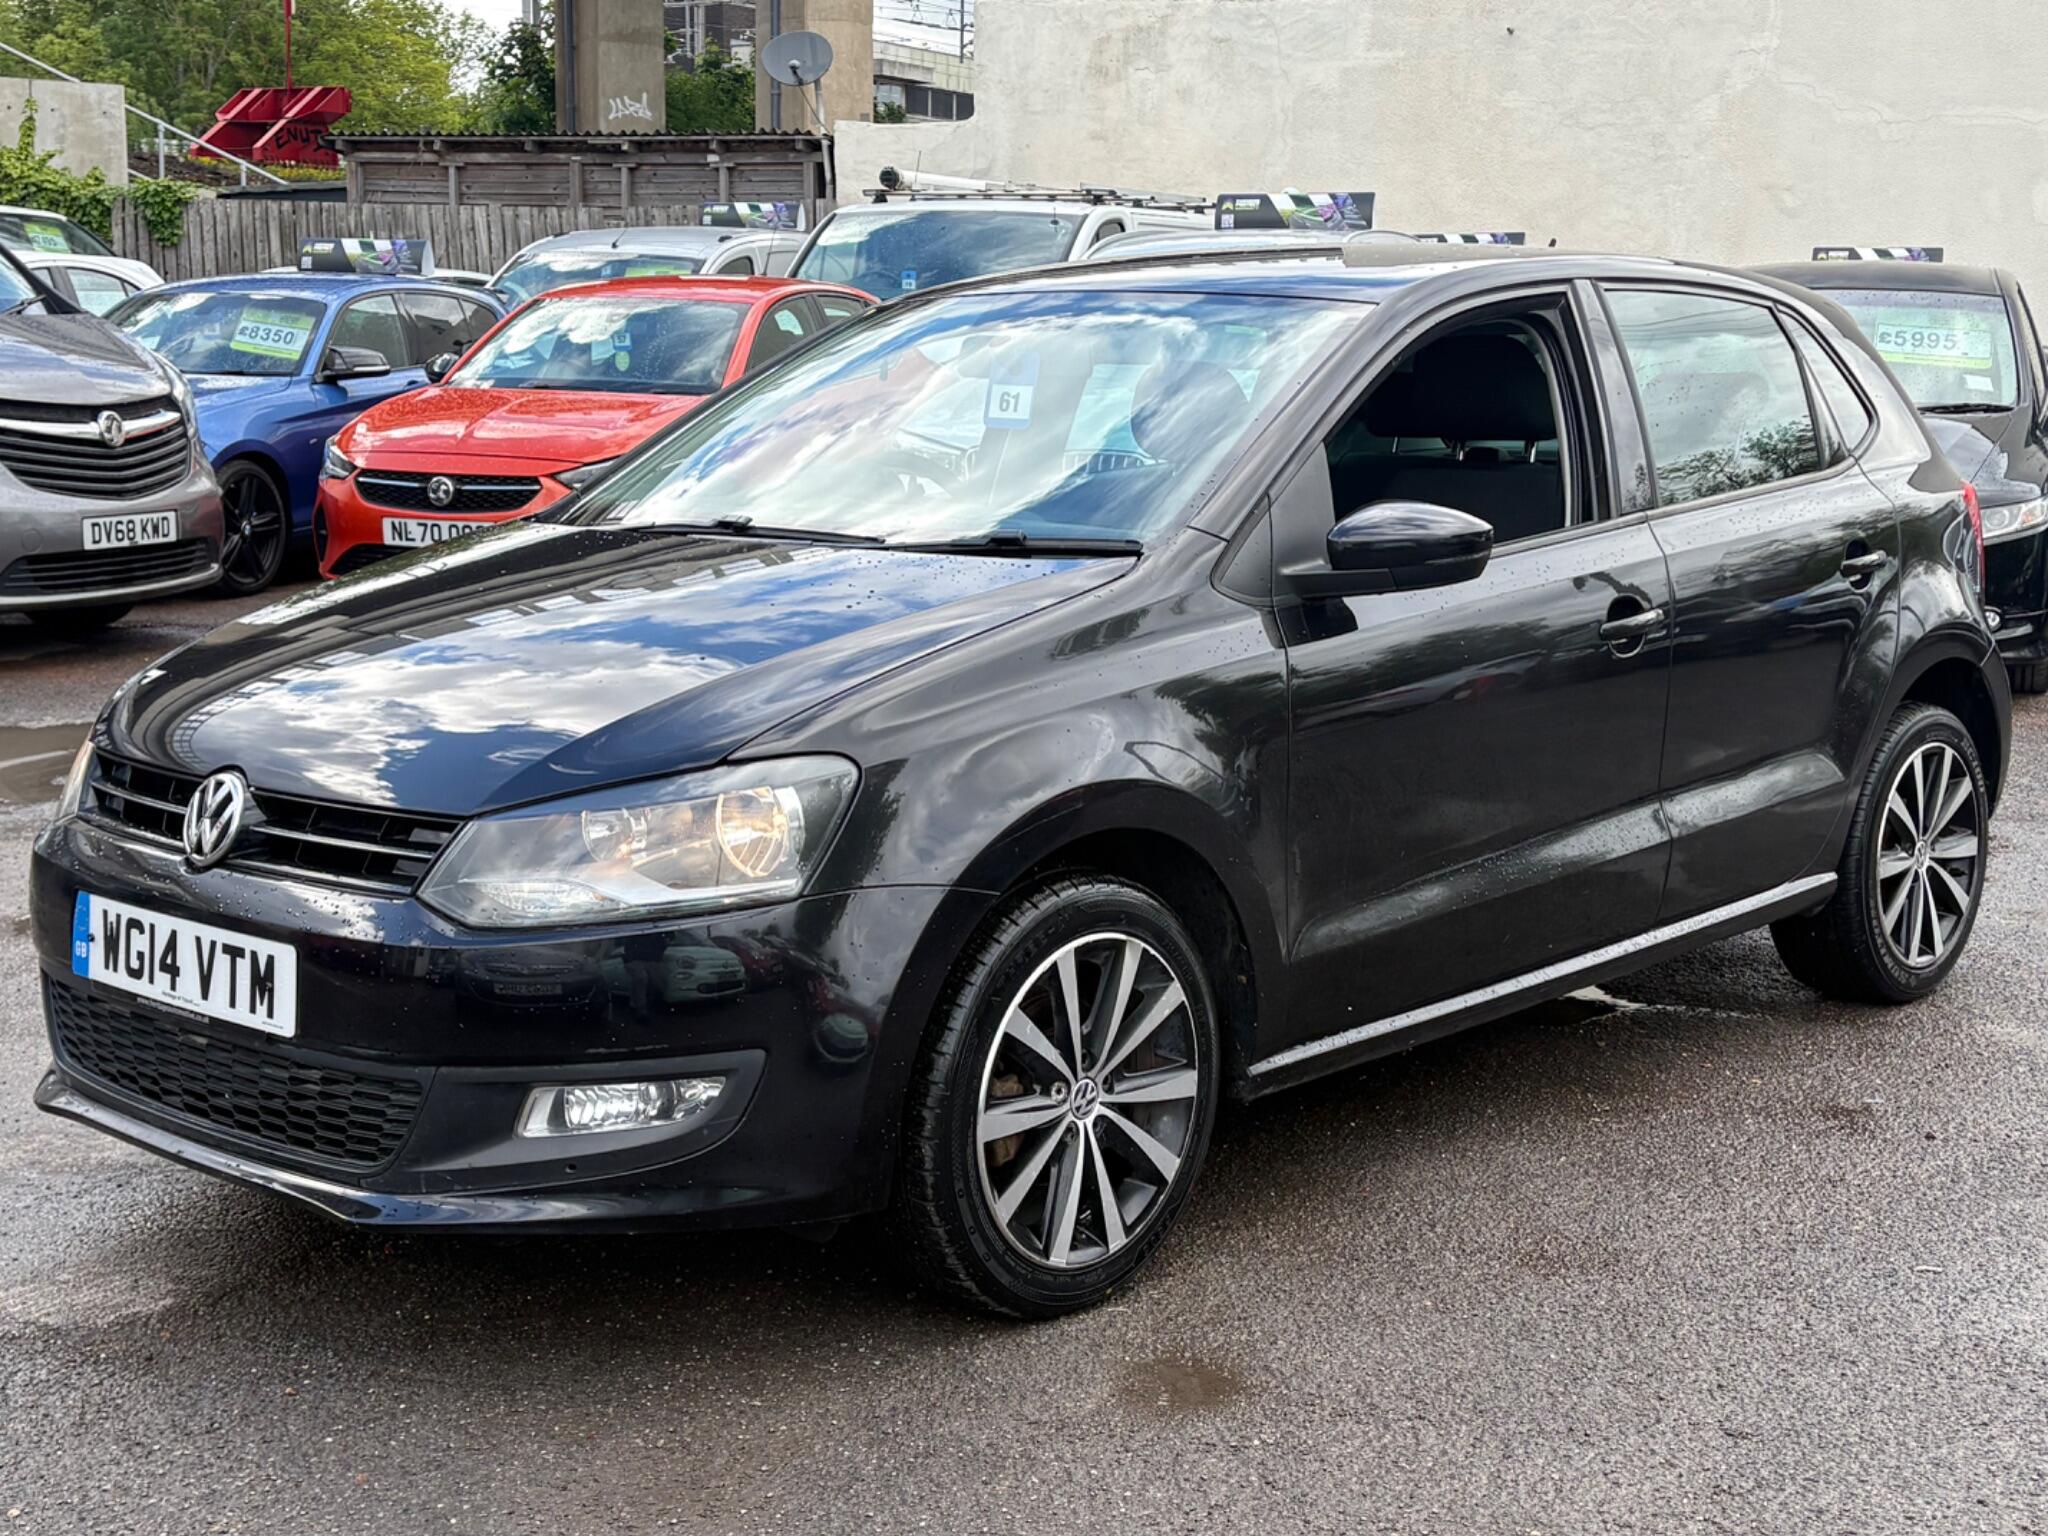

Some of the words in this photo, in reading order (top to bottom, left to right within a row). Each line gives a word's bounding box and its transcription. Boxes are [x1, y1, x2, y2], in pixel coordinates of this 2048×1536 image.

[238, 325, 295, 345] £8350
[1878, 329, 1958, 350] £5995
[998, 390, 1020, 413] 61
[91, 519, 136, 544] DV68
[140, 516, 170, 540] KWD
[390, 521, 443, 544] NL70
[75, 940, 87, 958] GB
[102, 908, 180, 992] WG14
[195, 934, 275, 1020] VTM
